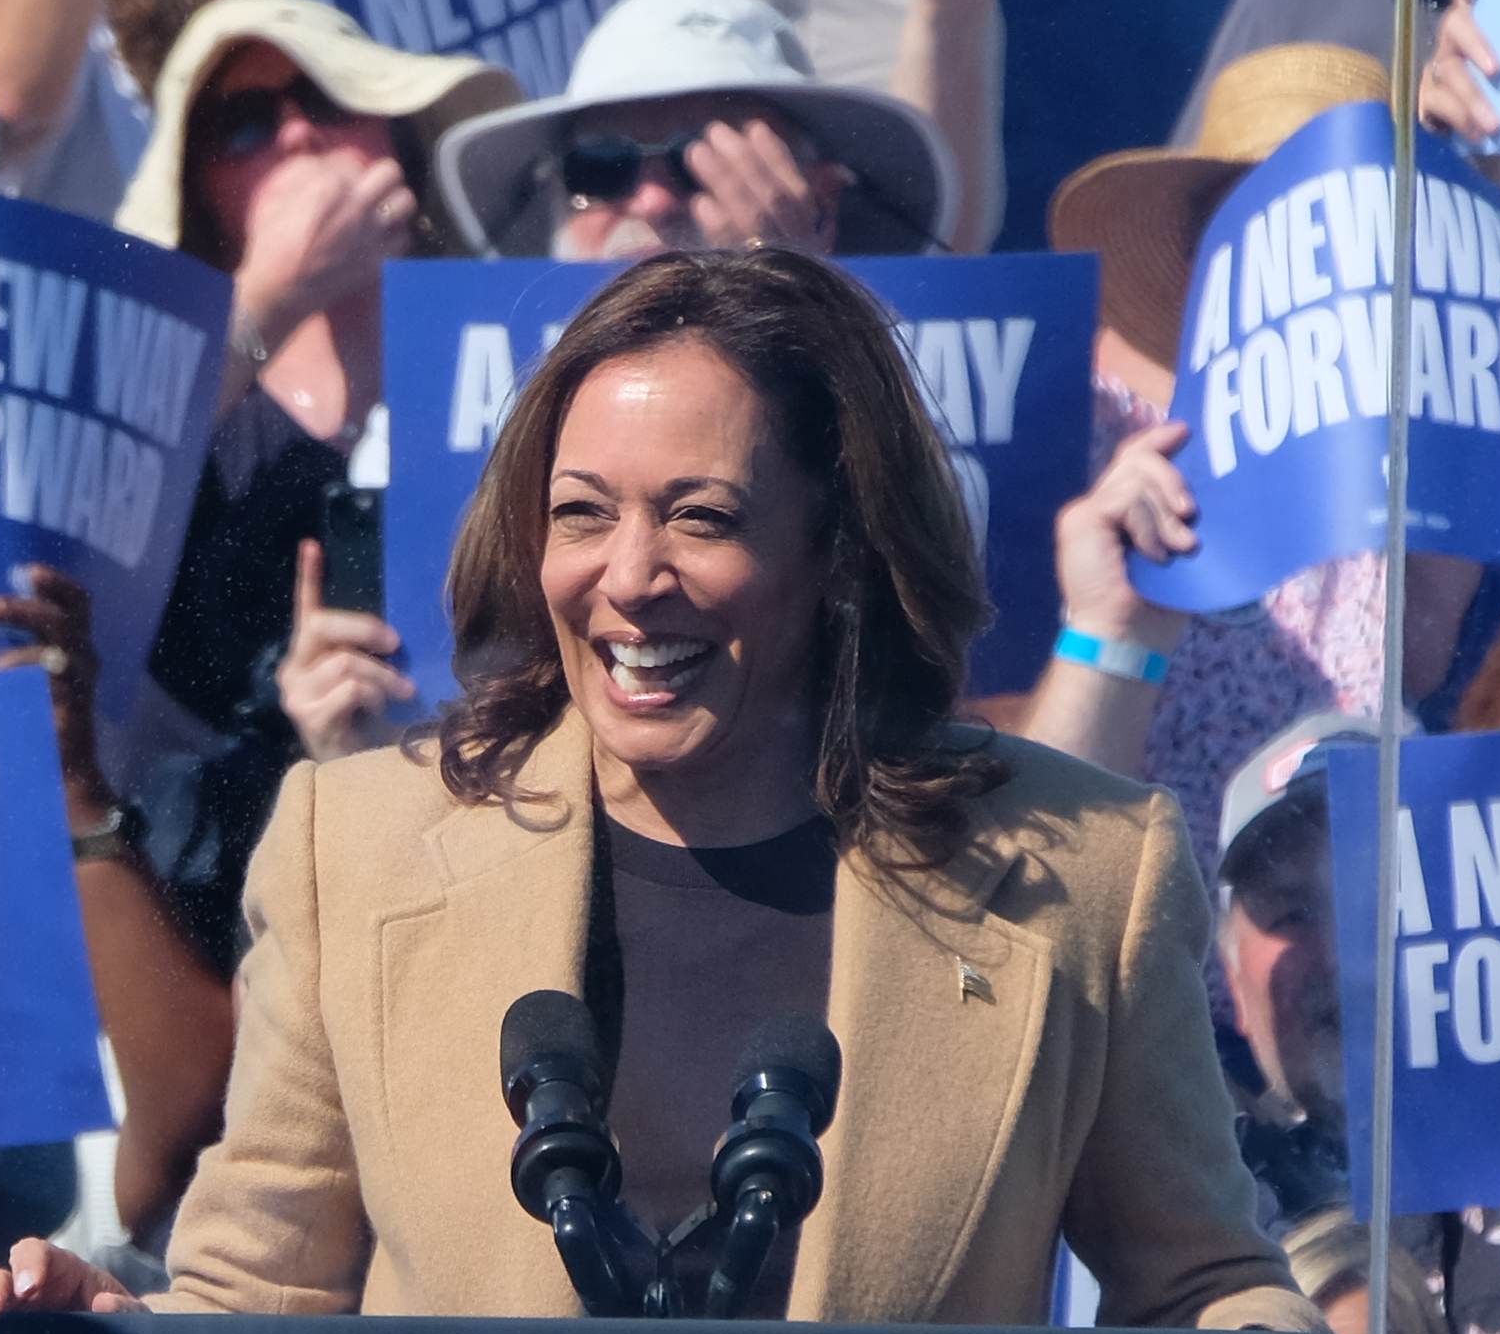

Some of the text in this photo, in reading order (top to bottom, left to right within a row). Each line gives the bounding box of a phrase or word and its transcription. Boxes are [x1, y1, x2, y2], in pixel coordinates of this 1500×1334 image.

[90, 289, 208, 449] WAY
[1190, 242, 1236, 369] A
[447, 322, 513, 454] A
